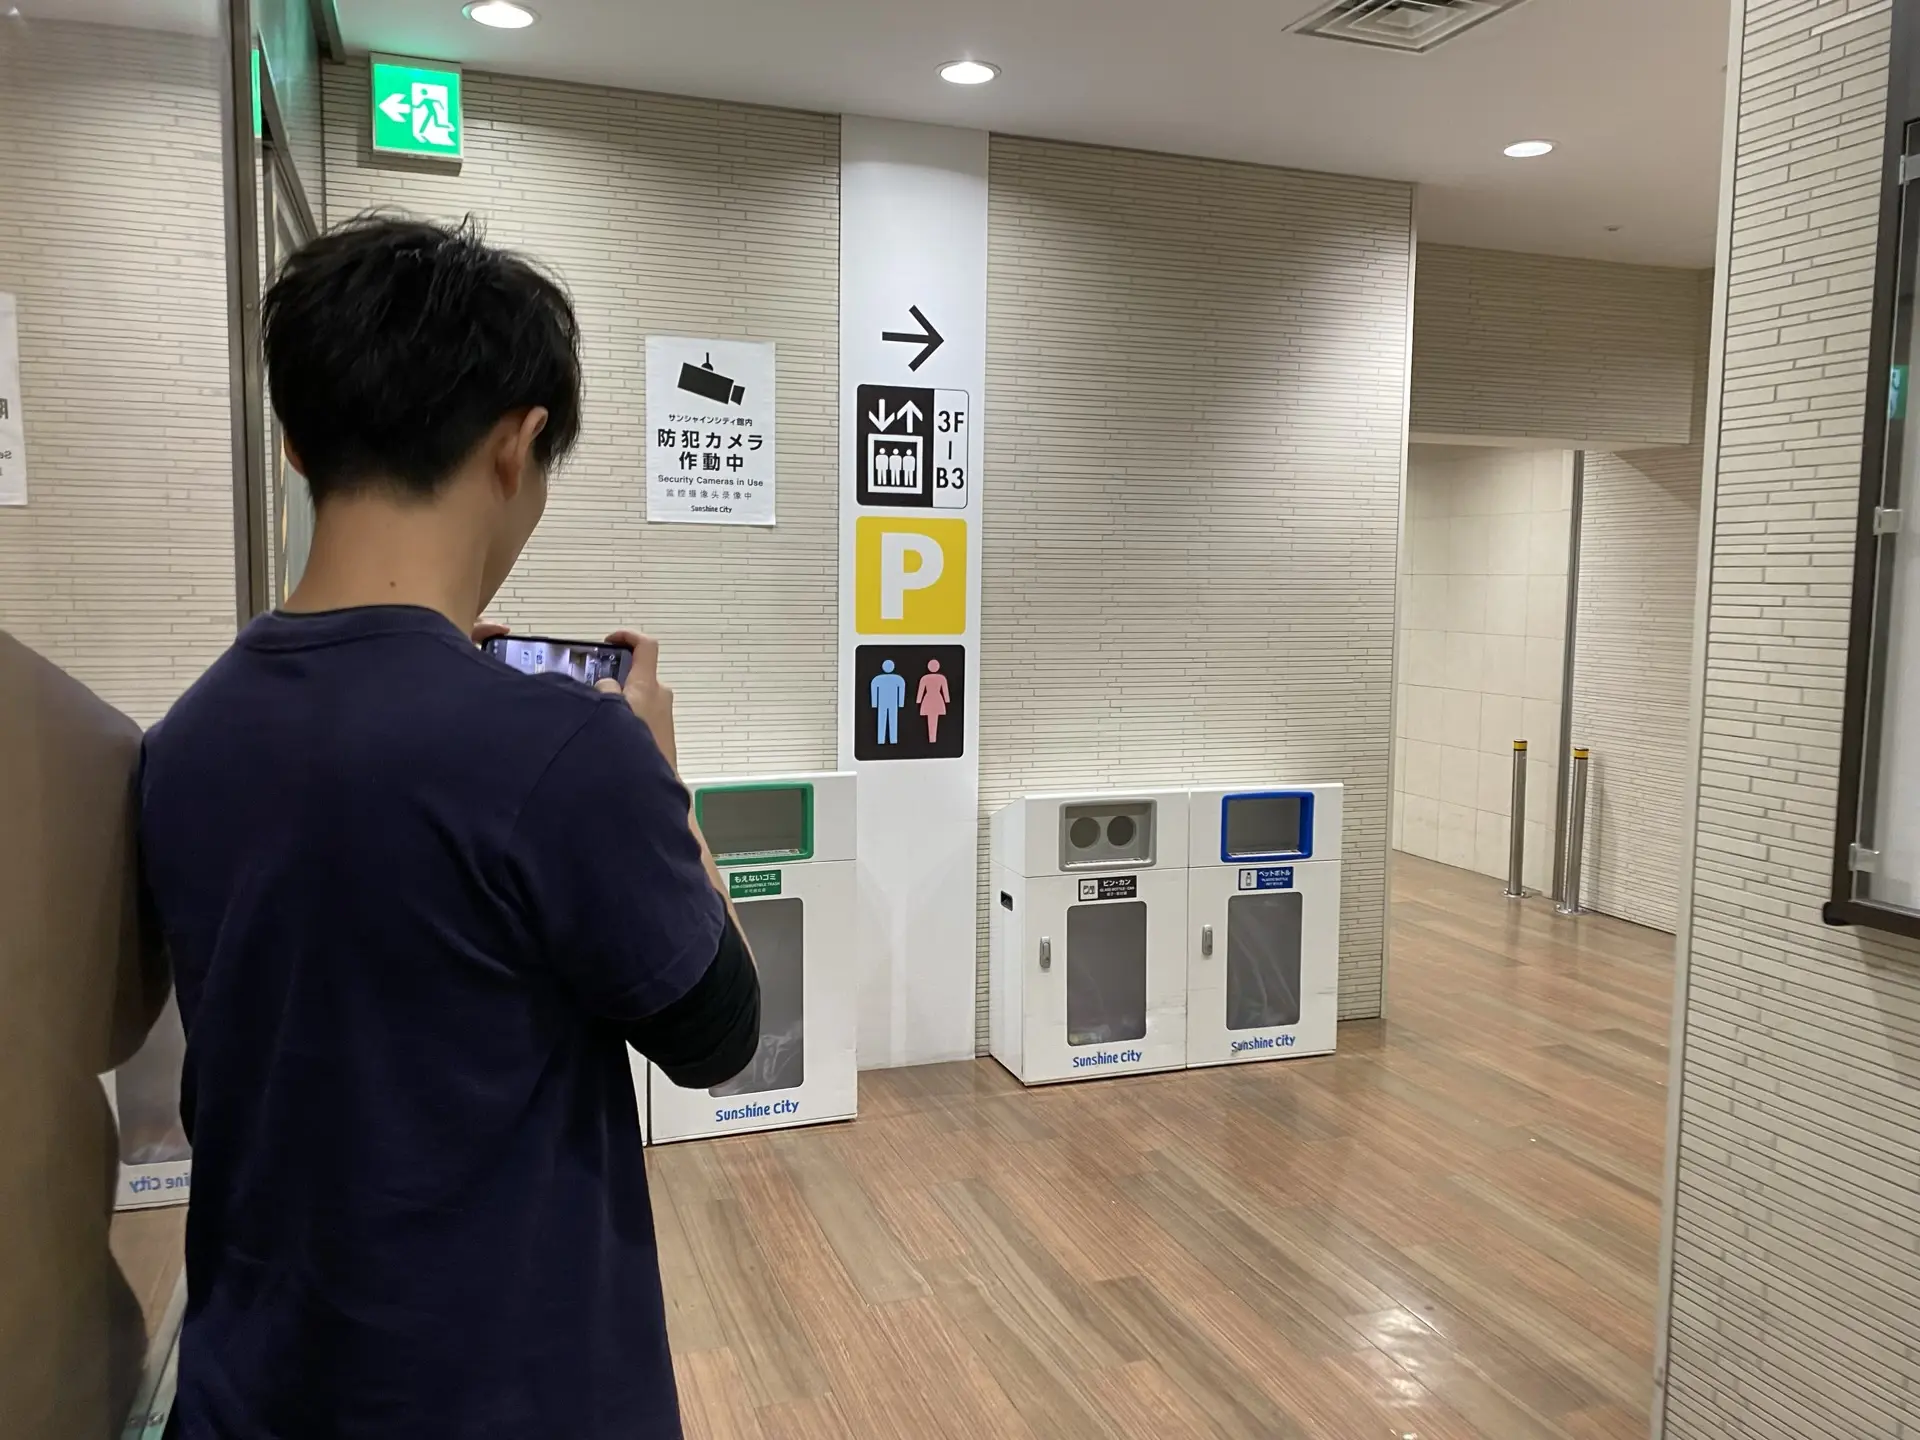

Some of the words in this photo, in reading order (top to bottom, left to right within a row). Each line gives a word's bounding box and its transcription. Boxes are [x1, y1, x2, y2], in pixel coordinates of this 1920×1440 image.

[668, 414, 753, 427] サンシャインシティ館内
[938, 411, 964, 433] 3F
[657, 428, 763, 451] 防犯カメラ
[679, 451, 744, 473] 作動中
[657, 474, 694, 485] Security
[696, 476, 734, 486] Cameras
[747, 478, 764, 487] Use
[936, 467, 964, 490] B3
[690, 504, 718, 513] Sunshine
[719, 506, 732, 514] City
[880, 531, 944, 620] P
[734, 873, 776, 884] もえないゴミ
[1231, 1037, 1273, 1052] Sunshine
[1275, 1034, 1296, 1048] City
[1073, 1051, 1118, 1068] Sunshine
[1120, 1050, 1142, 1063] City
[715, 1102, 771, 1122] Sunshine
[773, 1099, 800, 1114] City
